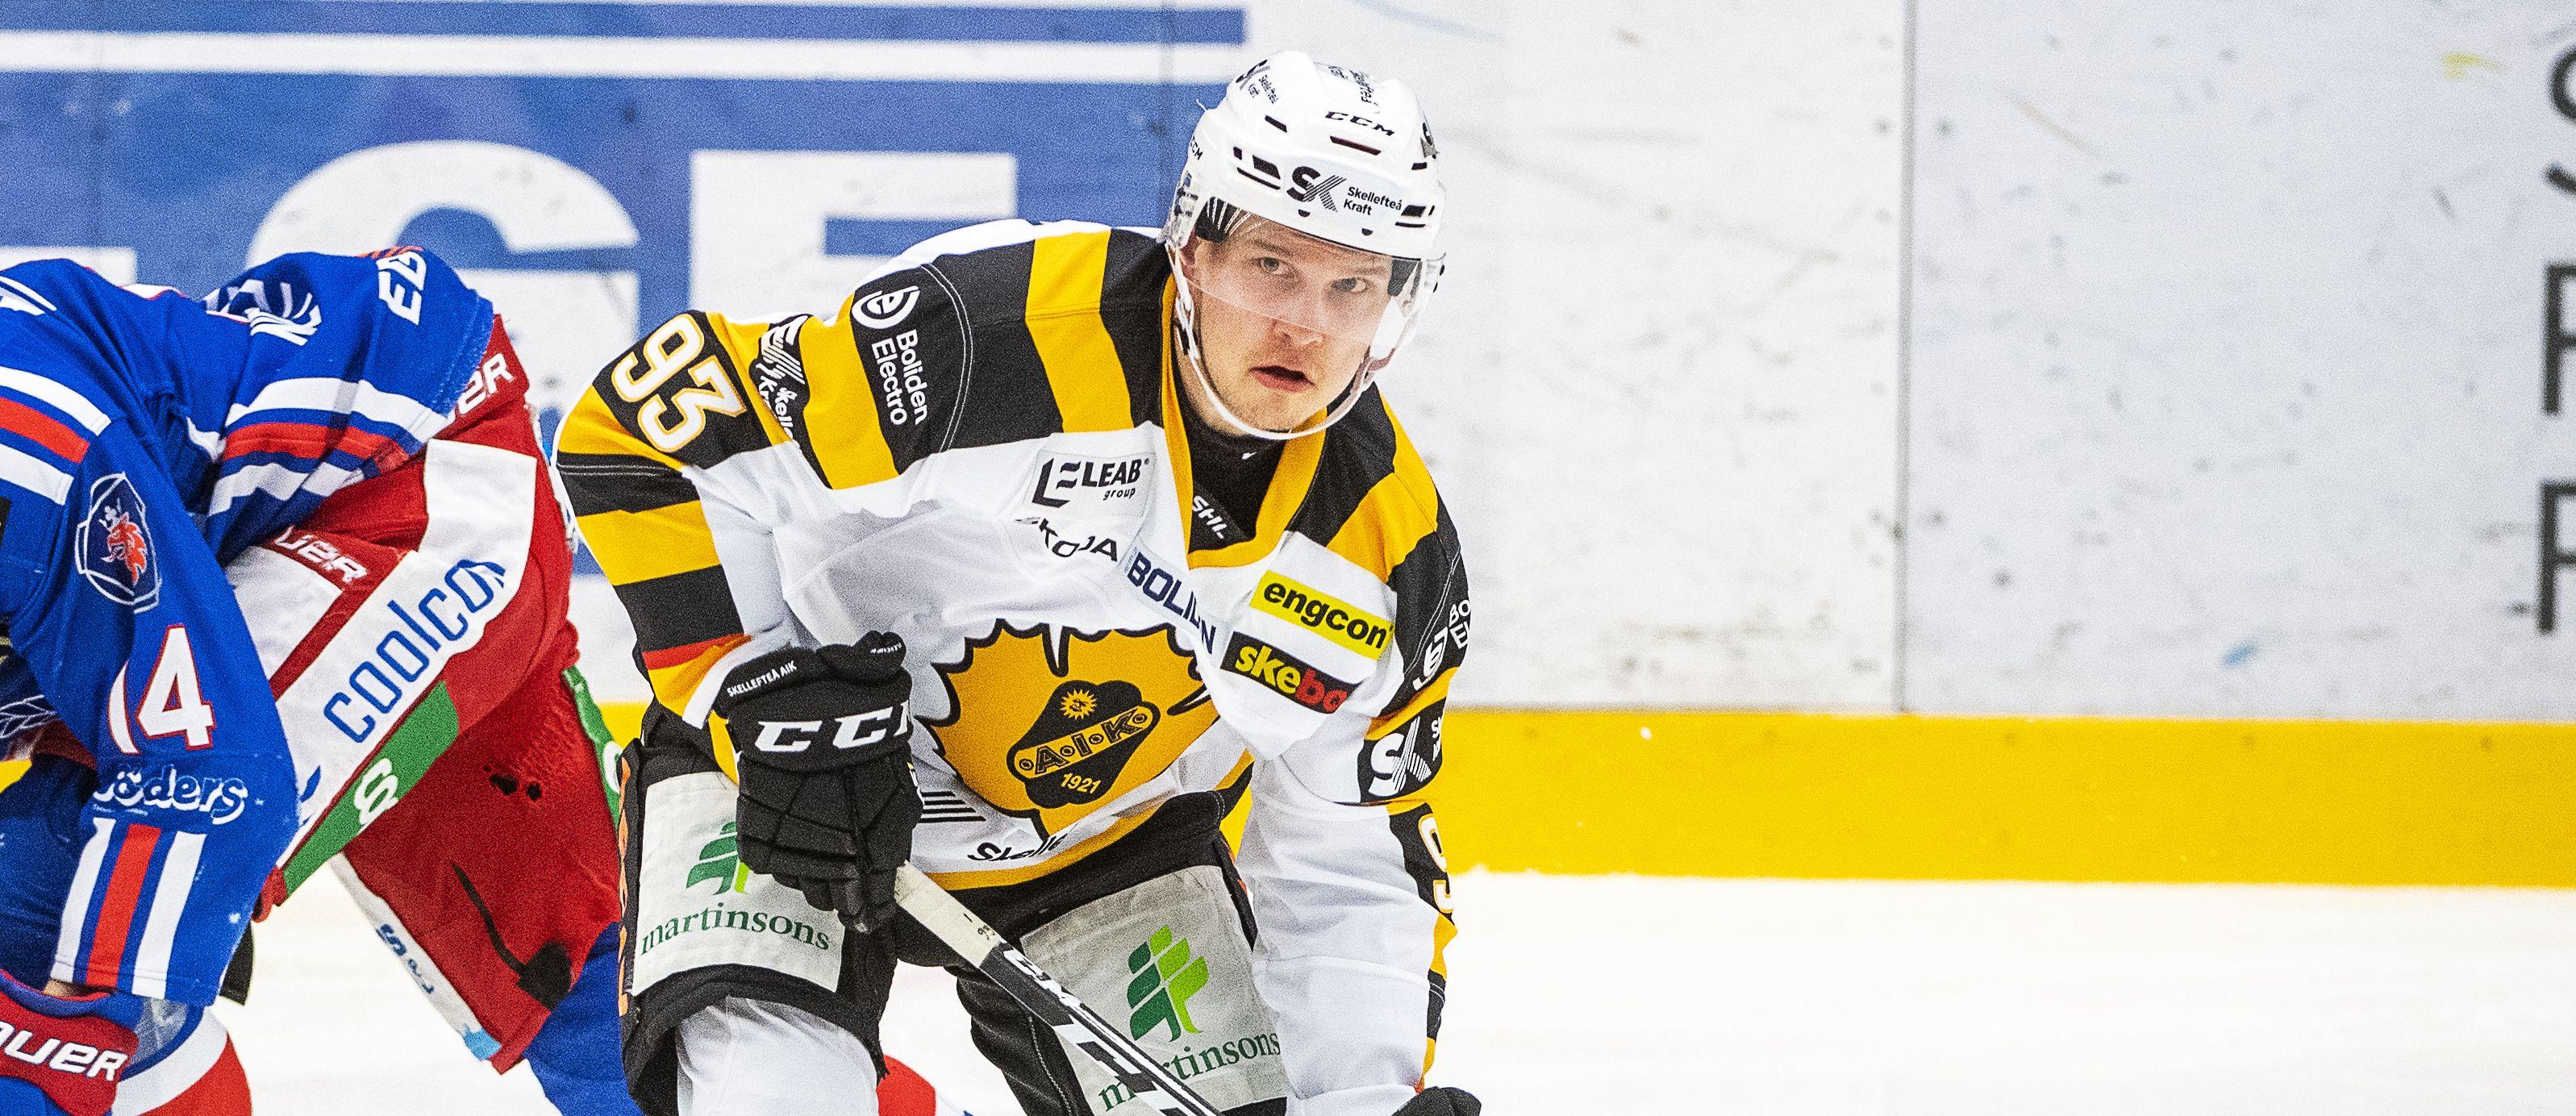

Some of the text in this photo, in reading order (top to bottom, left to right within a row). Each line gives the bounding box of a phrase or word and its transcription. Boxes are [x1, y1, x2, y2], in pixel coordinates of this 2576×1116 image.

[1325, 110, 1395, 137] CCM
[1343, 199, 1373, 216] Kraft
[1347, 186, 1403, 211] Skellefteå
[611, 314, 748, 453] 93
[871, 339, 907, 427] Electro
[898, 328, 928, 425] Boliden
[1103, 487, 1136, 501] group
[1191, 494, 1229, 539] SHL
[1264, 580, 1388, 650] engcon
[727, 660, 798, 698] SKELLEFTEÅ AIK
[1235, 643, 1348, 714] skebo
[1061, 771, 1102, 793] 1921
[640, 902, 830, 956] martinsons
[1098, 1032, 1281, 1112] mtinsons
